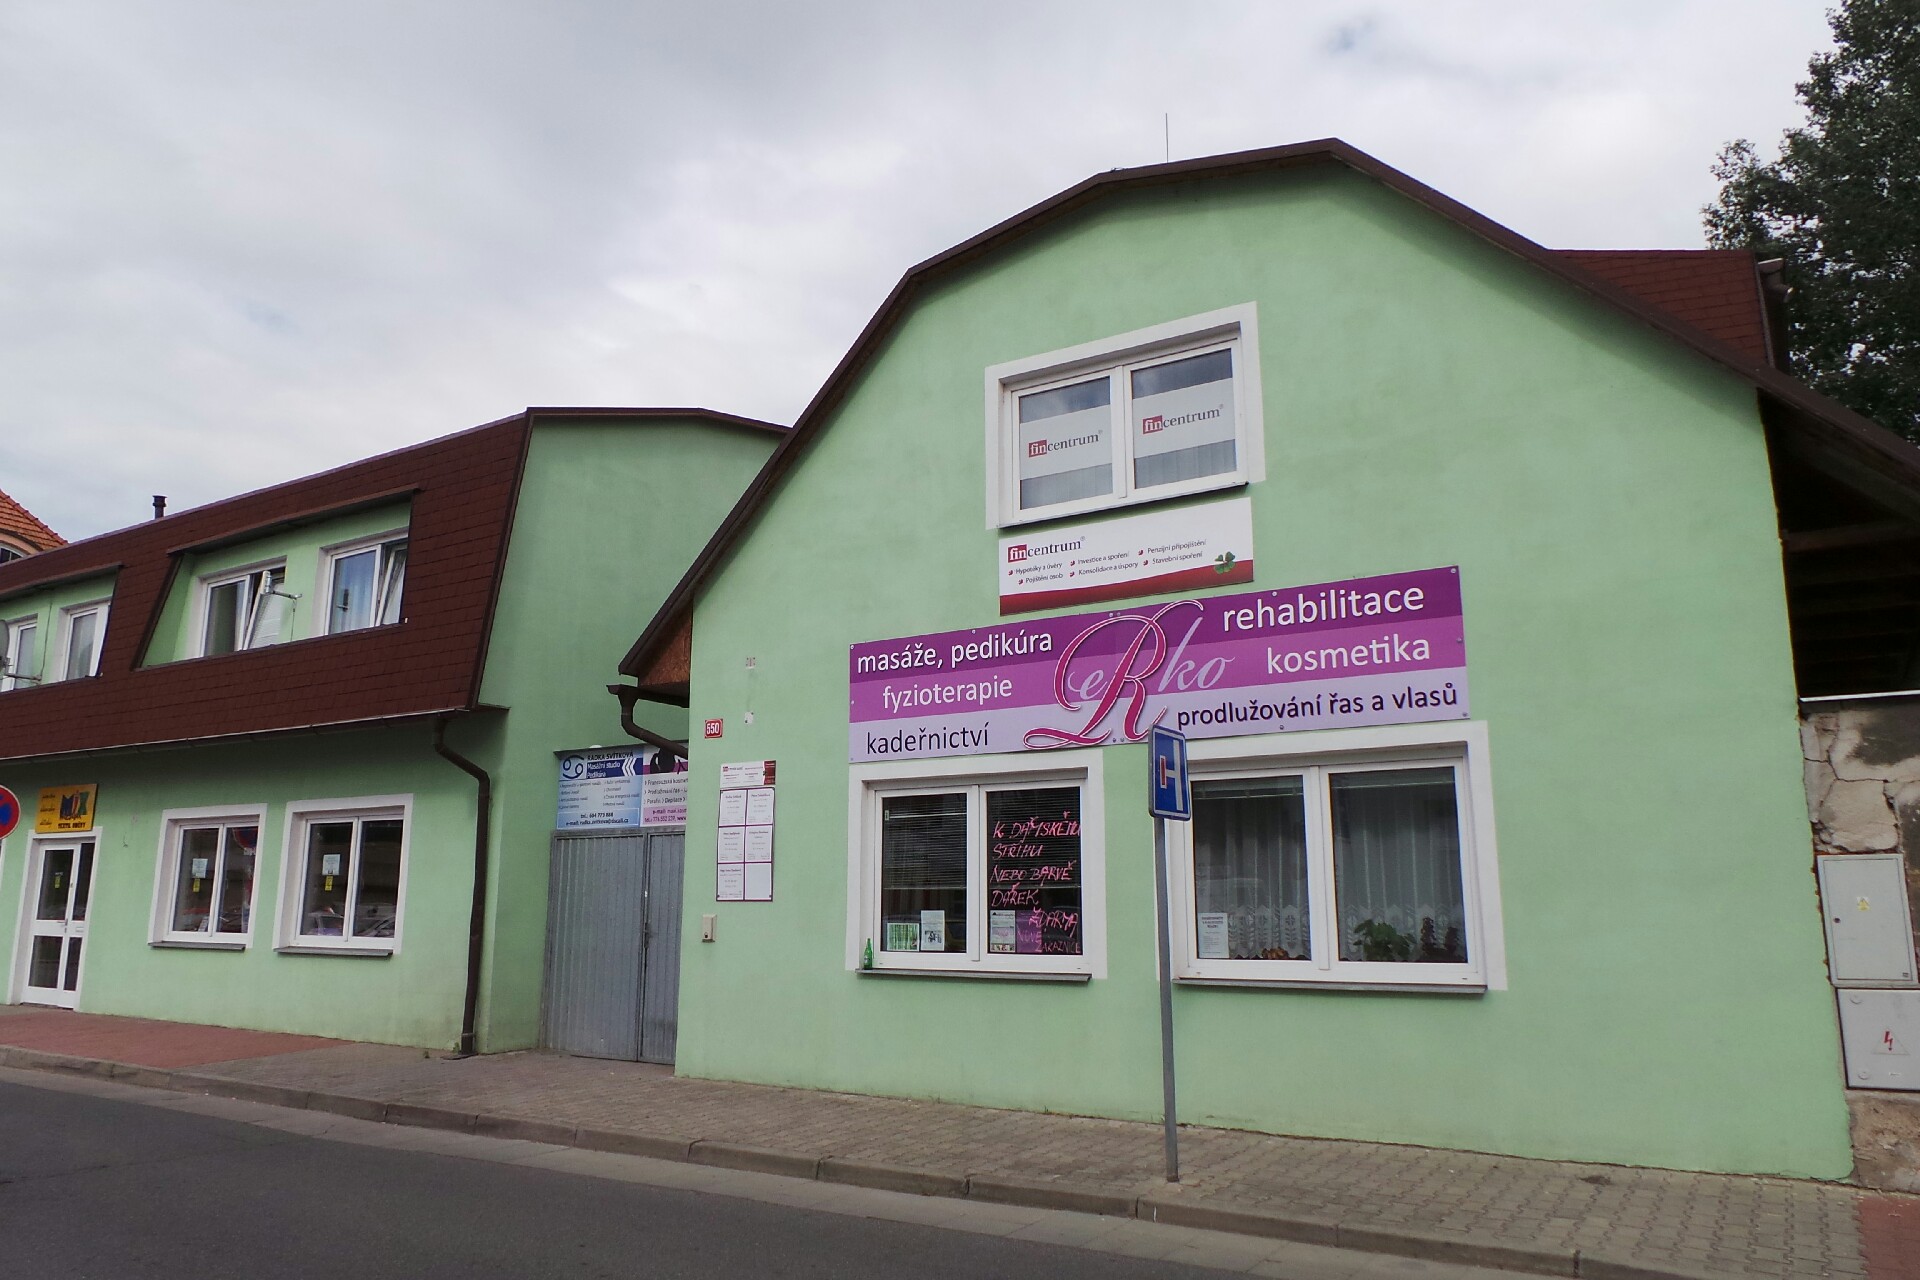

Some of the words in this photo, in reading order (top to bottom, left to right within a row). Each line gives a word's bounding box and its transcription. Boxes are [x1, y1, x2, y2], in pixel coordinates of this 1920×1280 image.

[1143, 409, 1221, 434] fincentrum
[1029, 434, 1100, 456] fincentrum
[1009, 540, 1082, 562] fincentrum
[1223, 586, 1424, 632] rehabilitace
[857, 642, 943, 674] masáže,
[951, 630, 1053, 668] pedikúra
[1266, 634, 1430, 675] kosmetika
[883, 675, 1013, 713] fyzioterapie
[1177, 694, 1322, 731] prodlužování
[1329, 692, 1364, 715] řas
[1371, 693, 1385, 711] a
[1391, 682, 1458, 710] vlasů
[706, 722, 720, 735] 550
[866, 722, 990, 755] kadeřnictví
[993, 820, 1005, 838] K
[990, 865, 1027, 882] NEBO
